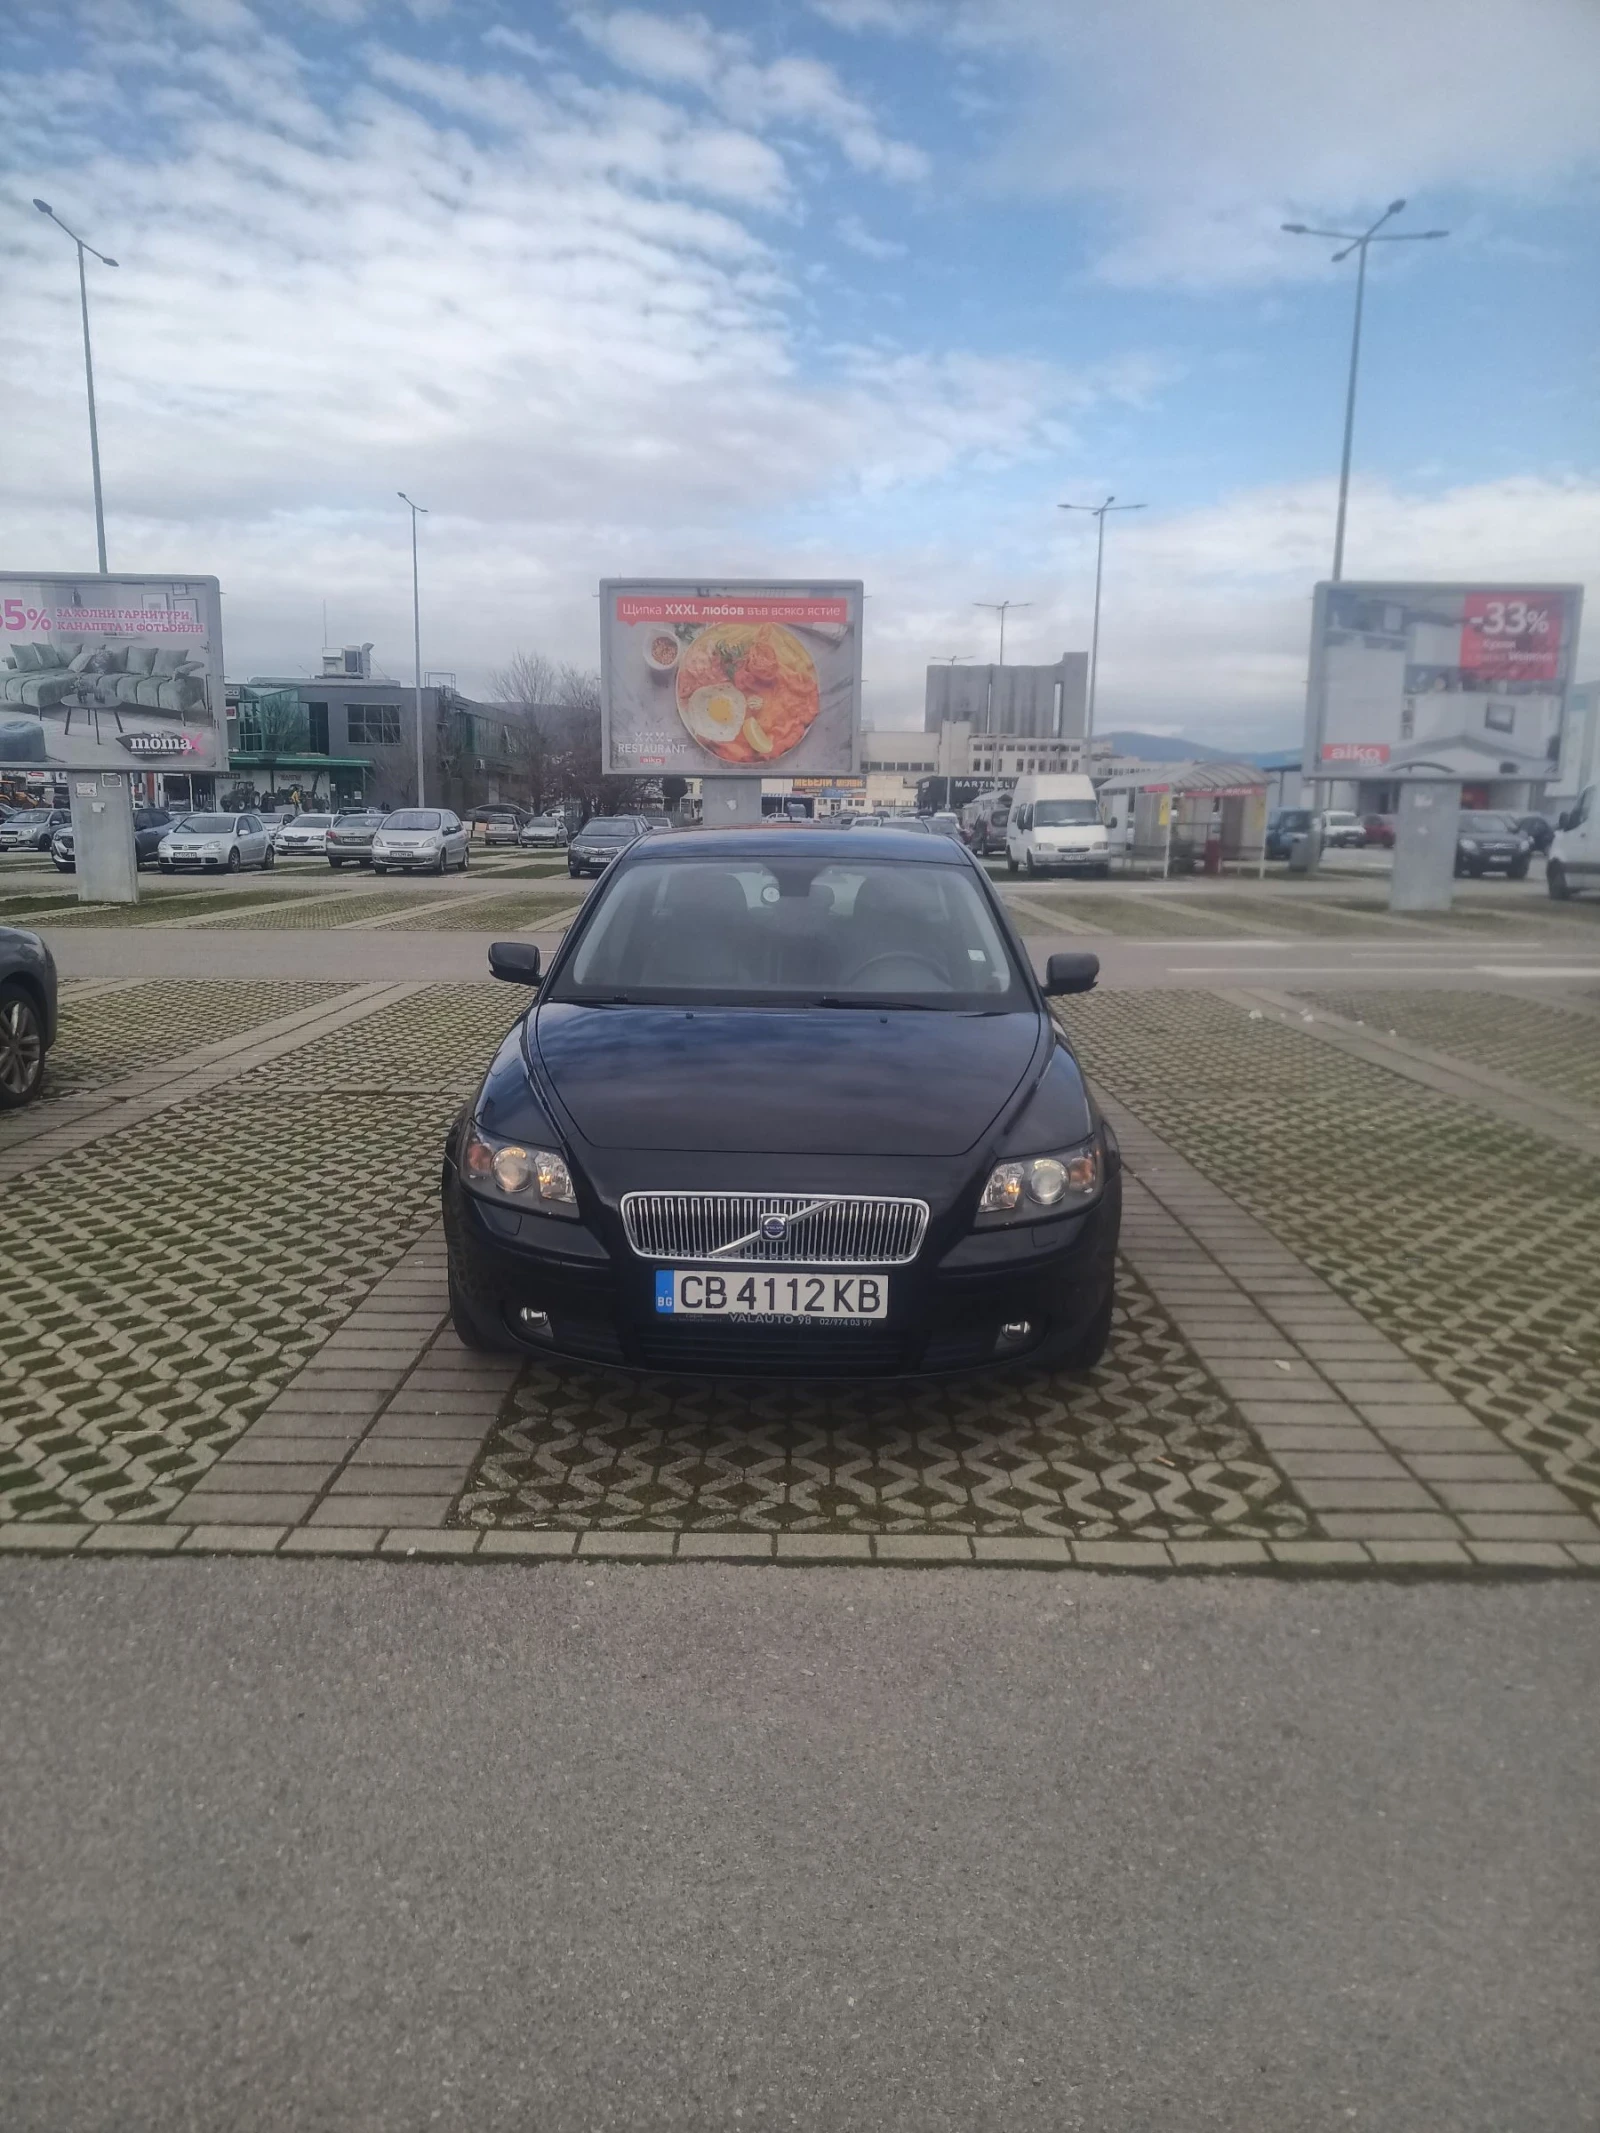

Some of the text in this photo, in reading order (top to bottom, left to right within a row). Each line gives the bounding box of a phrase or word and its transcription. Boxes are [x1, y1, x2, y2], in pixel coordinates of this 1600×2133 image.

[0, 600, 51, 630] 5%
[57, 608, 193, 620] ЗА ХОЛНИ ГАРНИТУРИ,
[622, 603, 840, 617] Щипка XXXL любов във всяко ястие
[1469, 602, 1549, 634] -33%
[57, 621, 204, 633] КАНАПЕТА И ФОТЬОЙЛИ
[618, 743, 687, 754] RESTAURANT
[1331, 744, 1380, 760] aiko
[736, 1276, 825, 1311] 4112
[657, 1296, 673, 1307] BG
[728, 1312, 794, 1325] VALAUTO
[797, 1315, 812, 1325] 98
